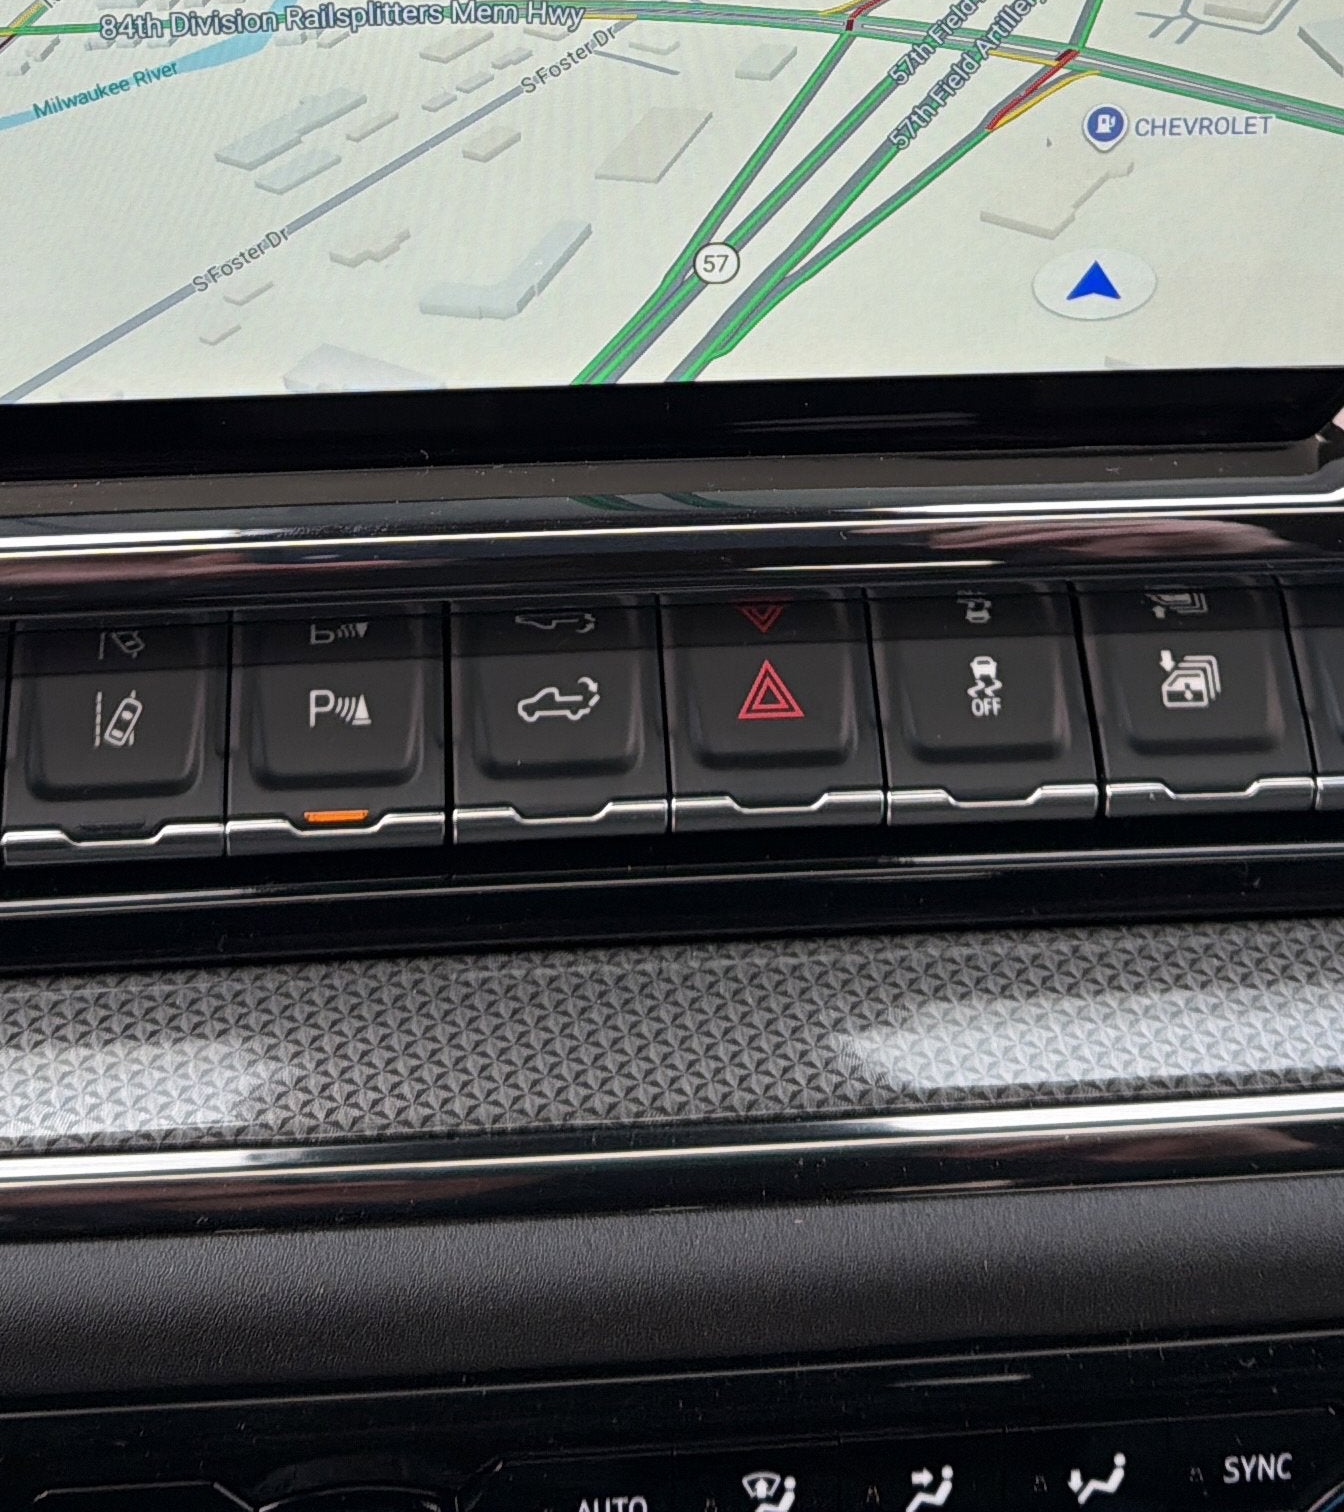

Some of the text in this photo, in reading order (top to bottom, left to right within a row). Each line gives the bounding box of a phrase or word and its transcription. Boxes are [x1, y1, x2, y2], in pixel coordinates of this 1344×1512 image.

[99, 12, 164, 41] 84th
[170, 7, 277, 38] Division
[284, 0, 445, 34] Railsplitters
[527, 0, 586, 33] Hwy
[520, 25, 616, 94] S Foster Dr
[888, 41, 934, 86] 57th
[32, 61, 179, 119] Milwaukee River
[888, 102, 940, 151] 57th
[928, 50, 983, 108] Field
[1134, 115, 1274, 137] CHEVROLET
[192, 226, 291, 293] S Foster Dr
[702, 254, 730, 274] 57
[971, 696, 1001, 717] OFF
[1222, 1451, 1294, 1485] SYNC
[578, 1495, 648, 1512] AUTO
